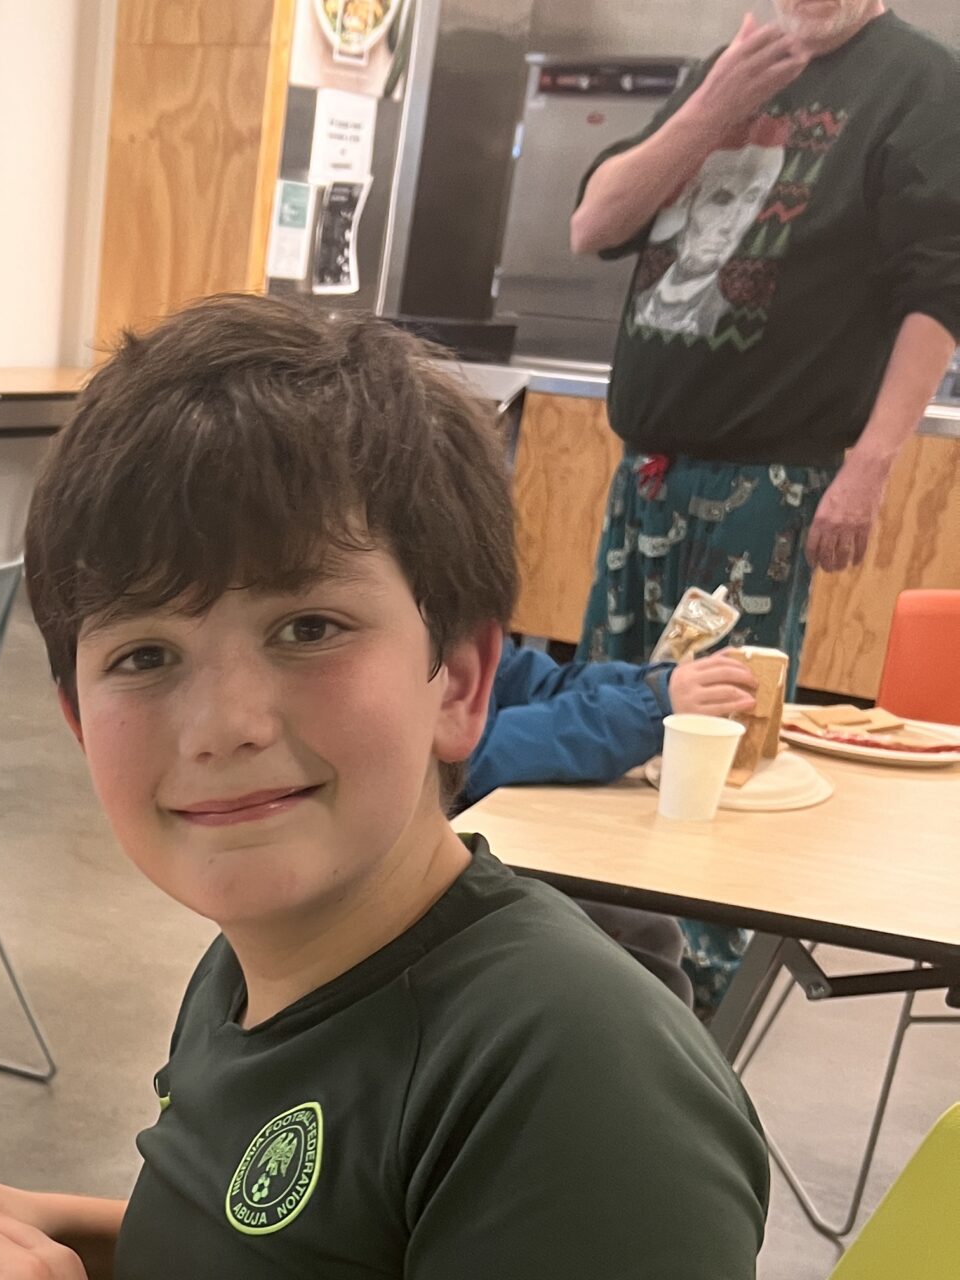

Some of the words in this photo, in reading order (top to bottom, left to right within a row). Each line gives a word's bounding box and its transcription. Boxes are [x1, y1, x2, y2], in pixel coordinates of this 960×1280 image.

[265, 1110, 315, 1137] FOOTBALL
[276, 1122, 317, 1218] FEDERATION
[232, 1202, 268, 1225] ABUJA
